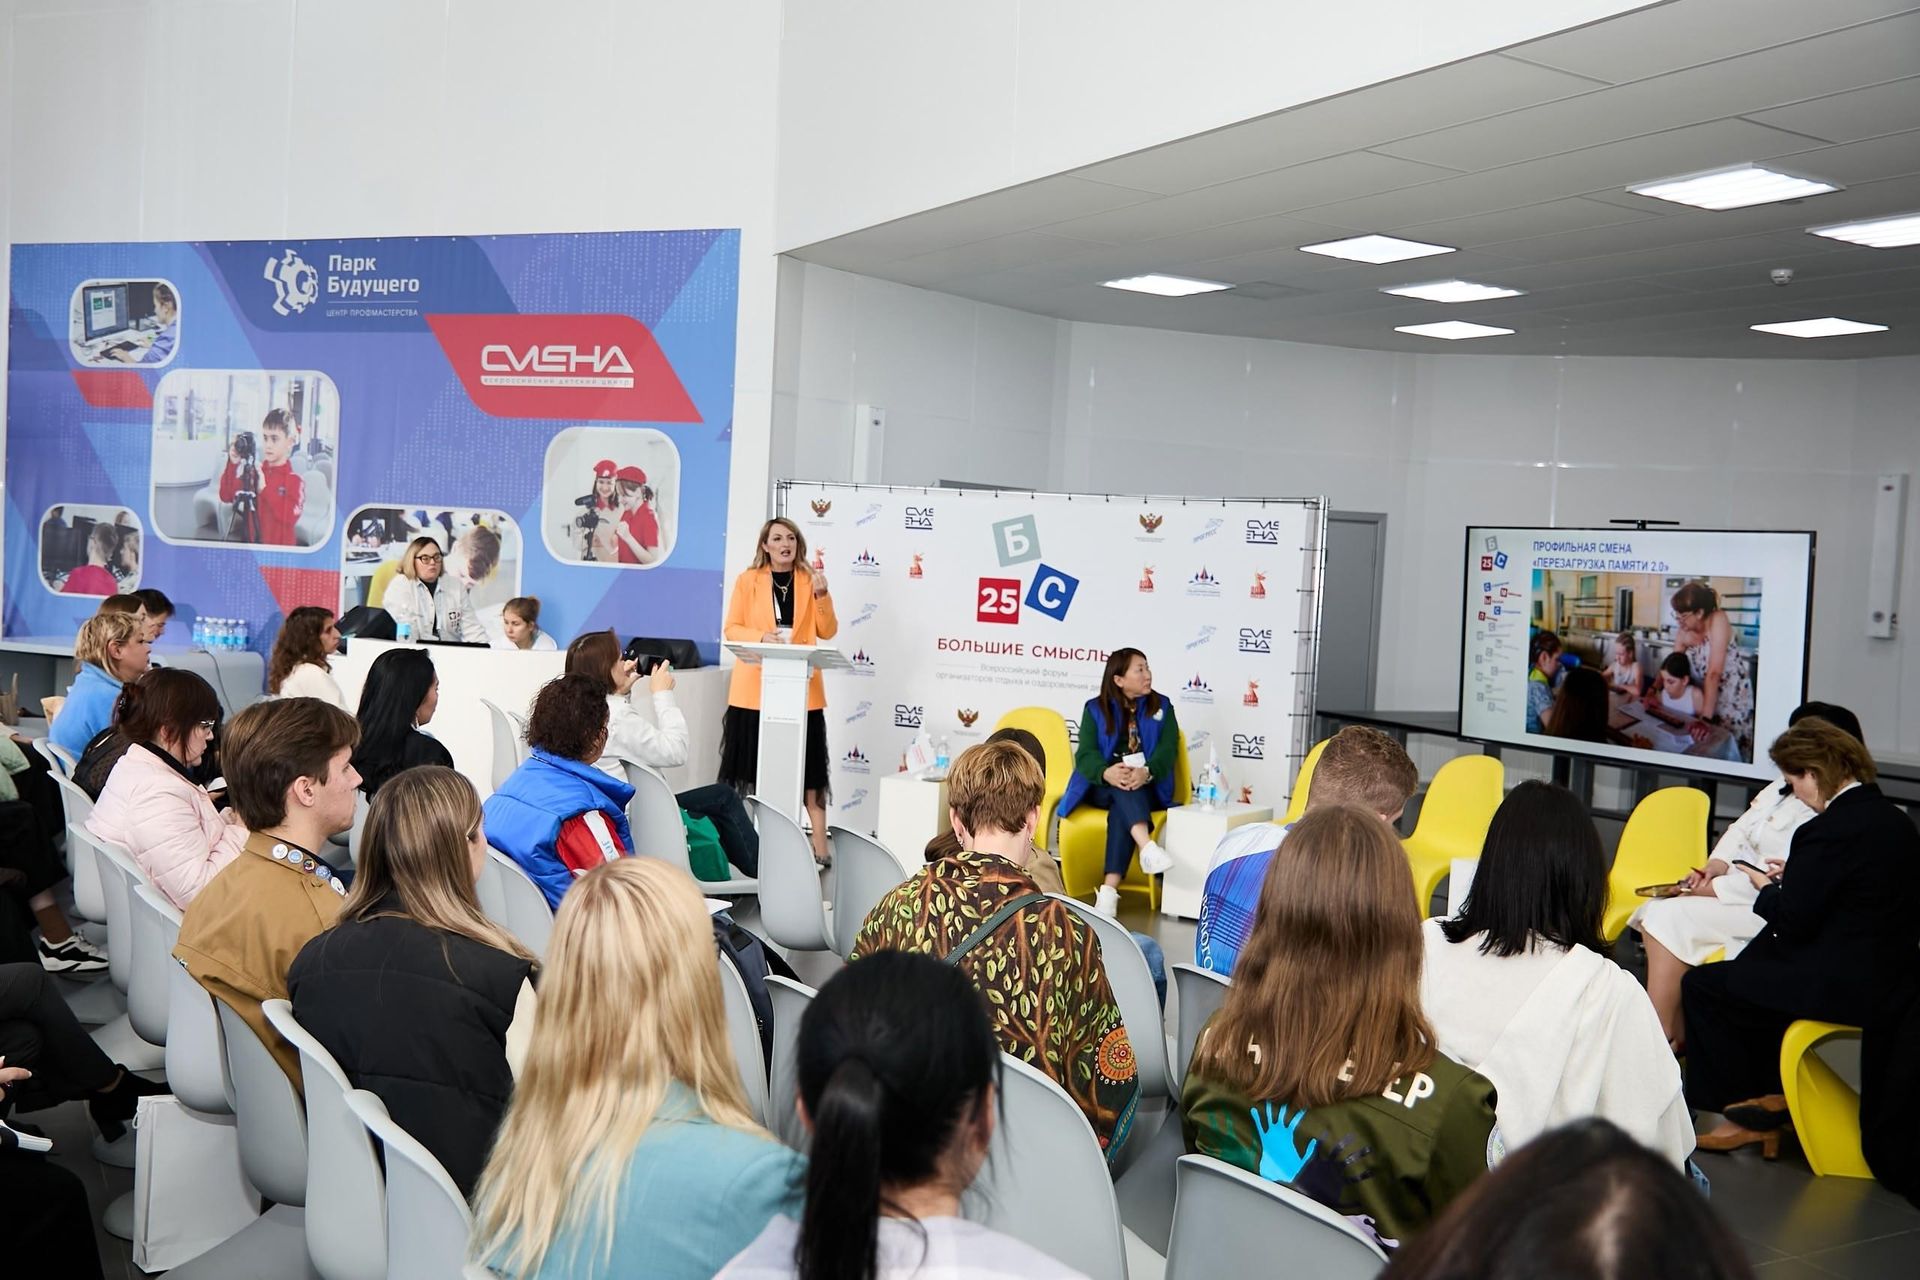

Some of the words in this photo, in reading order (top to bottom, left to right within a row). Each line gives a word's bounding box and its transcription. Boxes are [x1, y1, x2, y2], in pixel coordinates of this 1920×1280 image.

[329, 255, 377, 275] Парк
[327, 276, 420, 298] Будущего
[326, 309, 348, 318] ЦЕНТР
[350, 309, 418, 317] ПРОФМАСТЕРСТВА
[481, 344, 634, 373] СМЕНА
[1003, 523, 1030, 558] Б
[1533, 541, 1596, 553] ПРОФИЛЬНАЯ
[1599, 543, 1632, 554] СМЕНА
[1532, 557, 1606, 570] «ПЕРЕЗАГРУЗКА
[1608, 559, 1648, 571] ПАМЯТИ
[1650, 560, 1669, 572] 2.0»
[979, 587, 1018, 616] 25
[1037, 575, 1067, 609] С
[937, 638, 1024, 656] БОЛЬШИЕ
